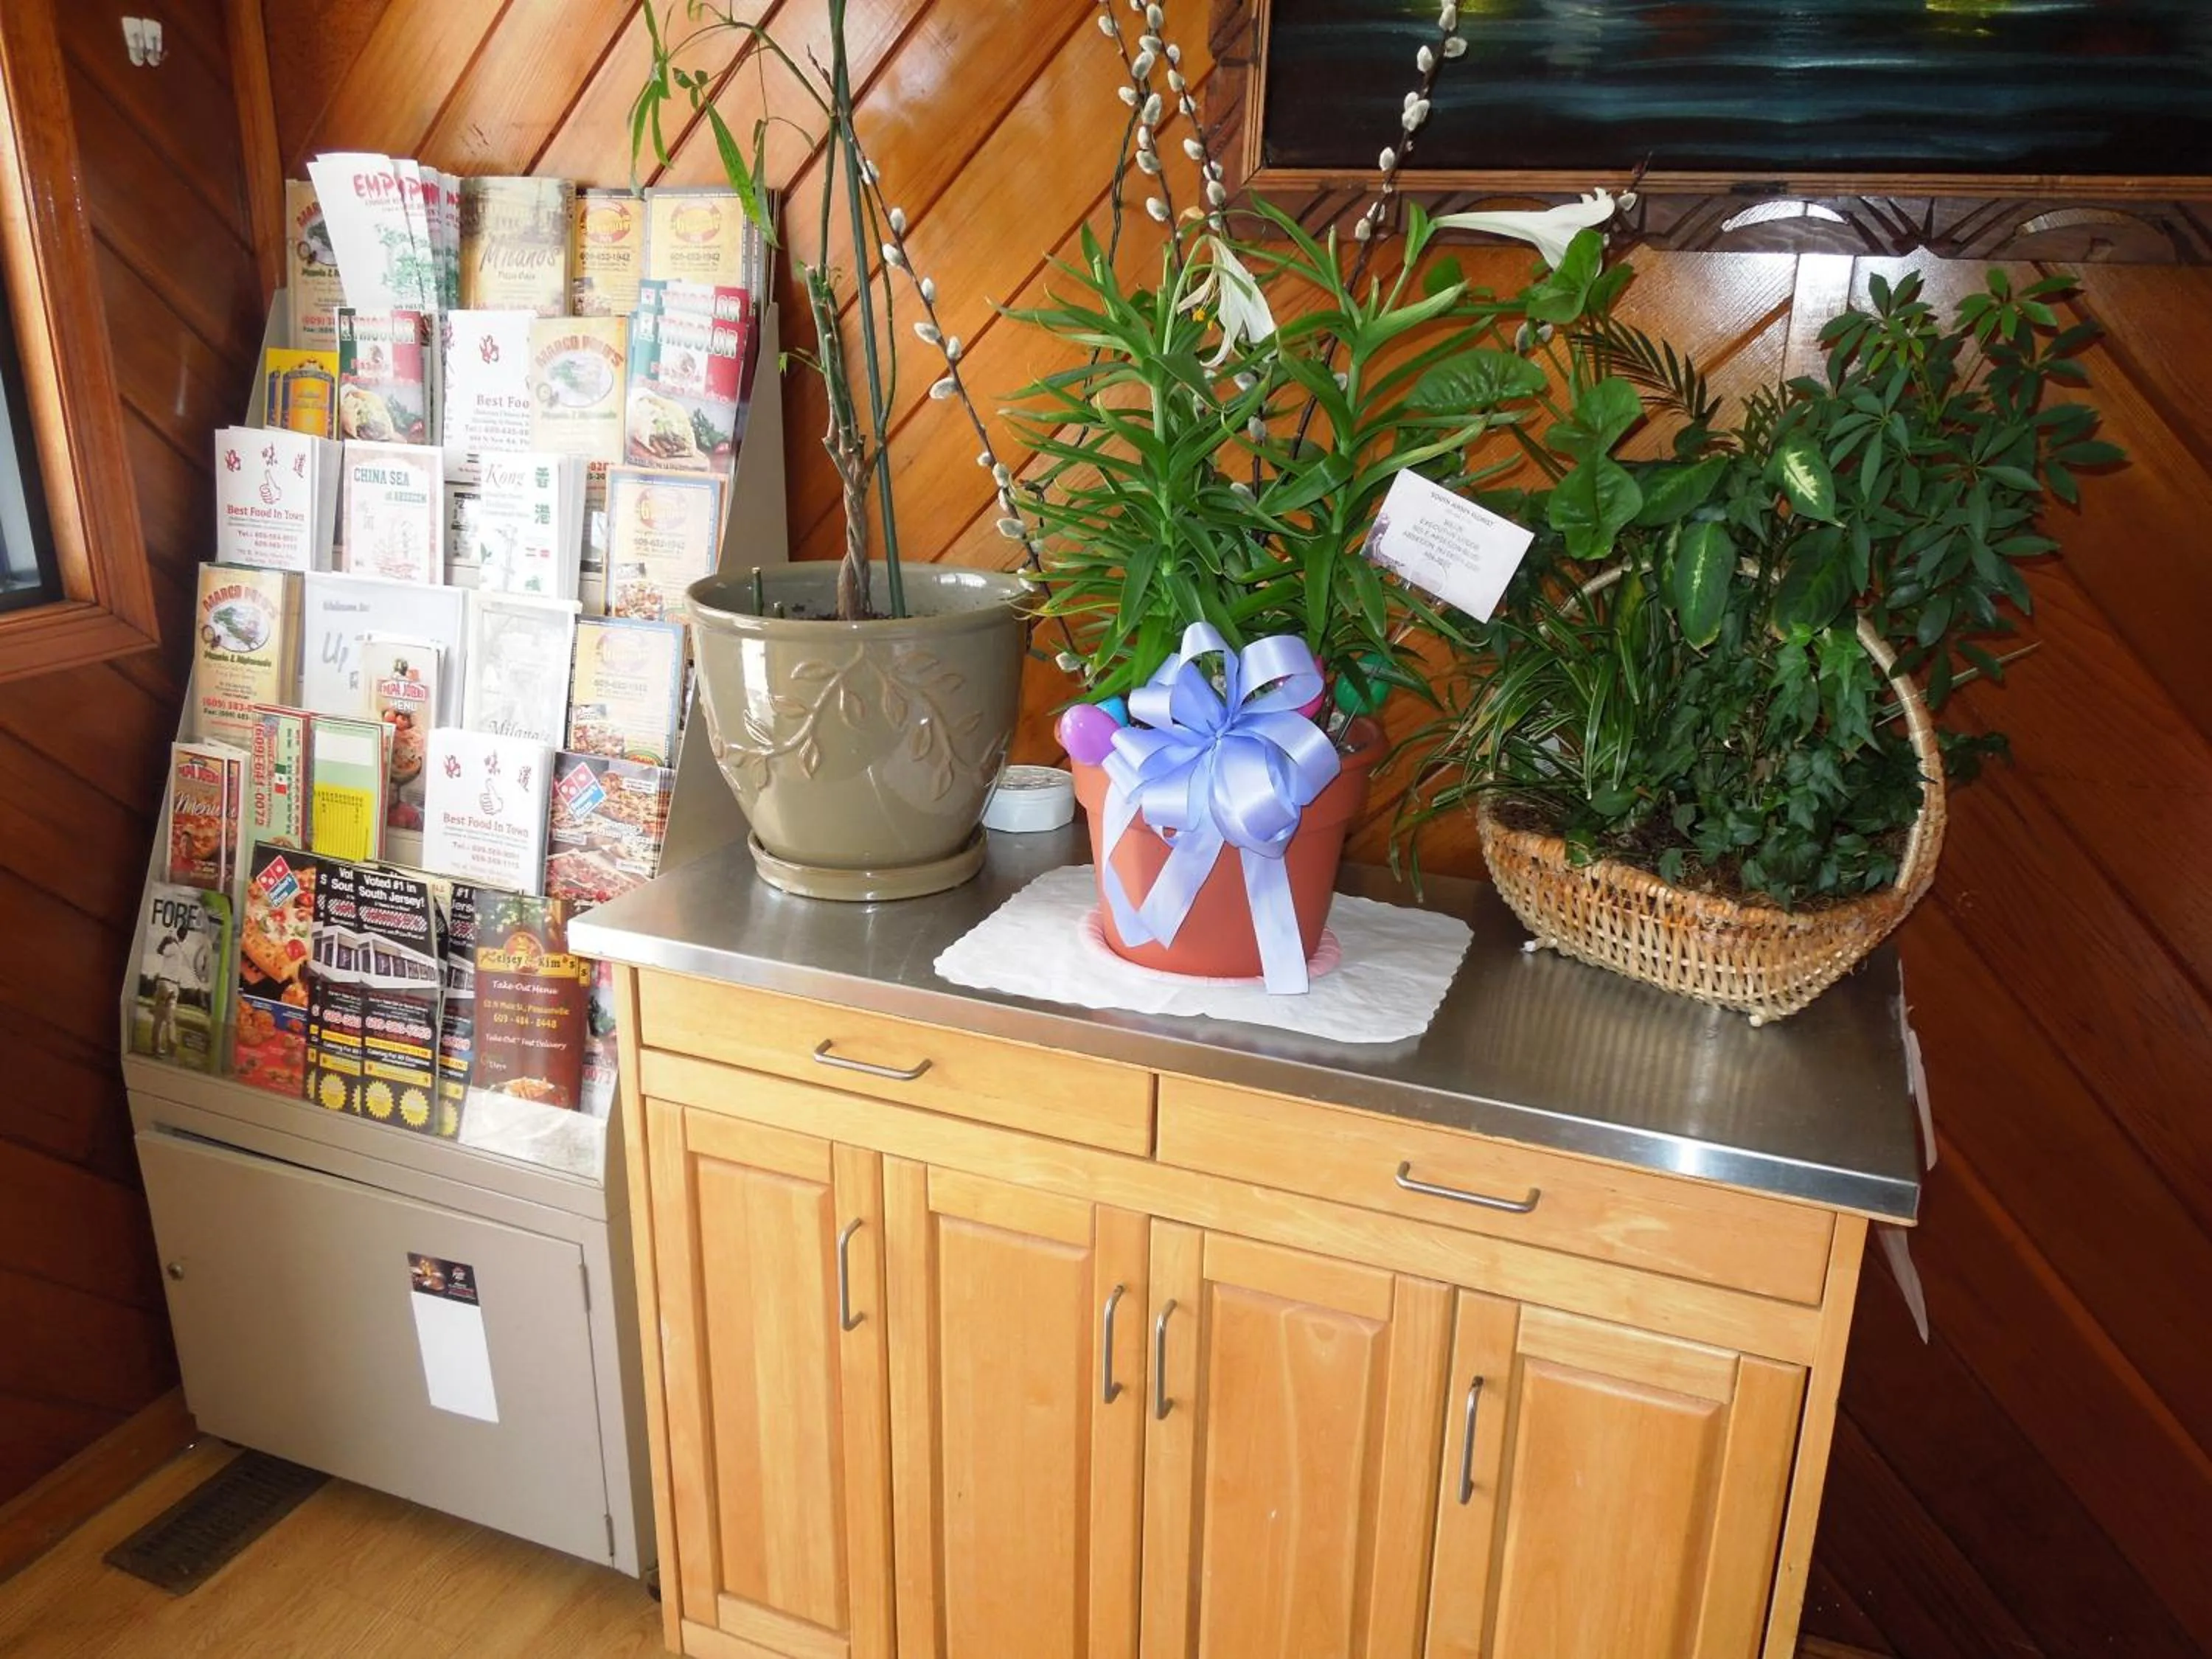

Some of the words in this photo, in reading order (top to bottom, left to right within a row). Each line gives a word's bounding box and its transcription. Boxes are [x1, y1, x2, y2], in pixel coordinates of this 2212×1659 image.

[476, 394, 504, 408] Best
[507, 396, 530, 409] Foo
[354, 467, 387, 485] CHINA
[389, 470, 411, 487] SEA
[227, 504, 248, 517] Best
[249, 505, 272, 518] Food
[274, 508, 283, 519] In
[201, 585, 243, 613] MARCO
[173, 790, 223, 817] Menu
[443, 812, 466, 827] Best
[467, 815, 493, 832] Food
[494, 819, 504, 832] In
[505, 822, 529, 838] Town
[338, 867, 354, 880] Vot
[331, 878, 354, 893] Sout
[363, 874, 391, 889] Voted
[392, 877, 406, 891] #1
[406, 880, 417, 894] in
[455, 885, 469, 897] #1
[358, 886, 388, 900] South
[388, 890, 425, 908] Jersey!
[152, 899, 198, 931] FORE
